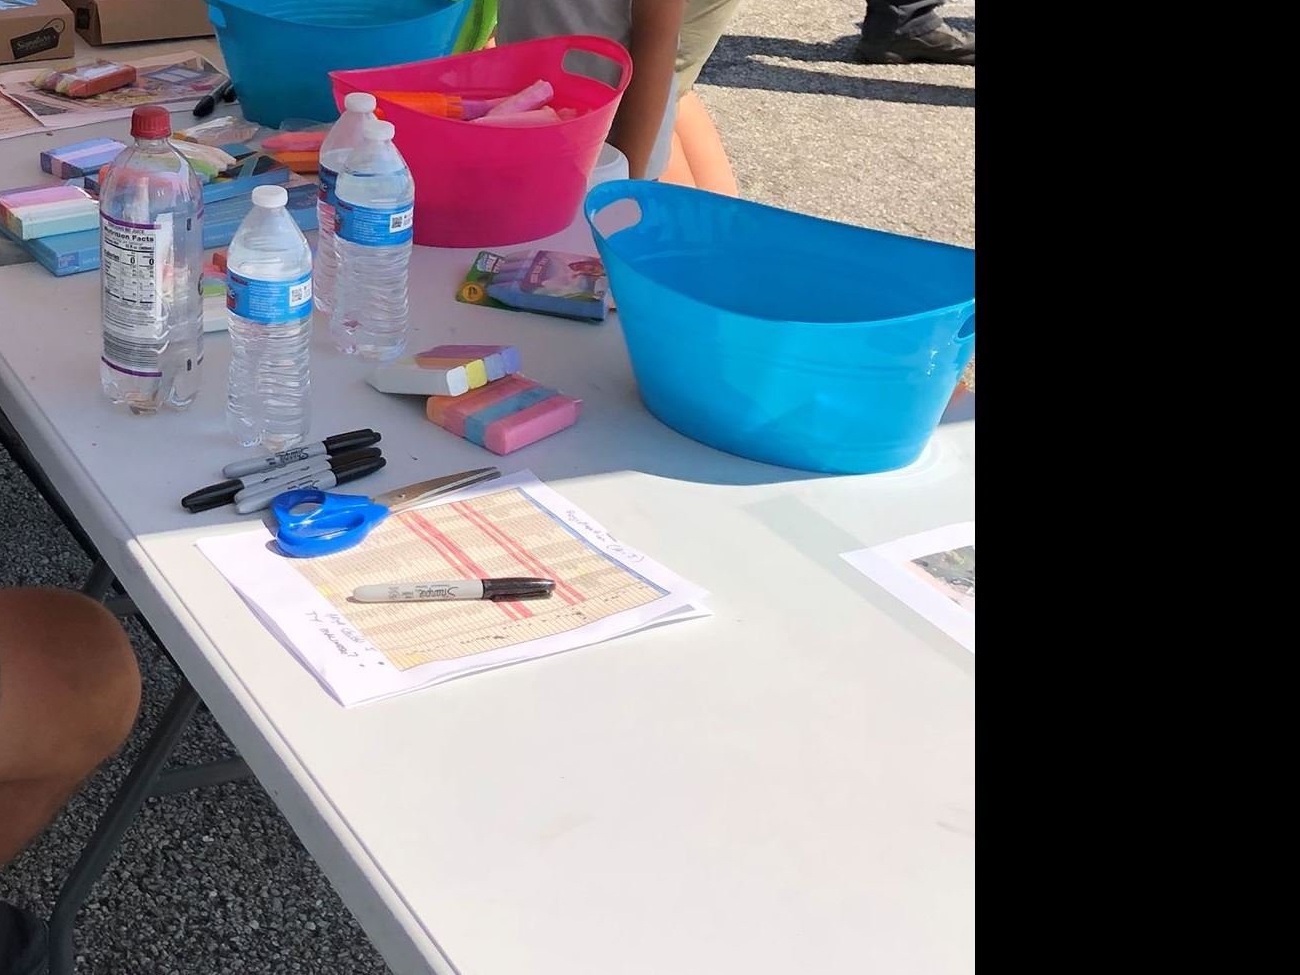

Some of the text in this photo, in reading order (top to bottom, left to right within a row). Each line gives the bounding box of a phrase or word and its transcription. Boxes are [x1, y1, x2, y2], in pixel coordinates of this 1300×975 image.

[104, 226, 130, 240] Nutrition
[131, 234, 154, 242] Facts
[417, 586, 459, 598] Sharpie
